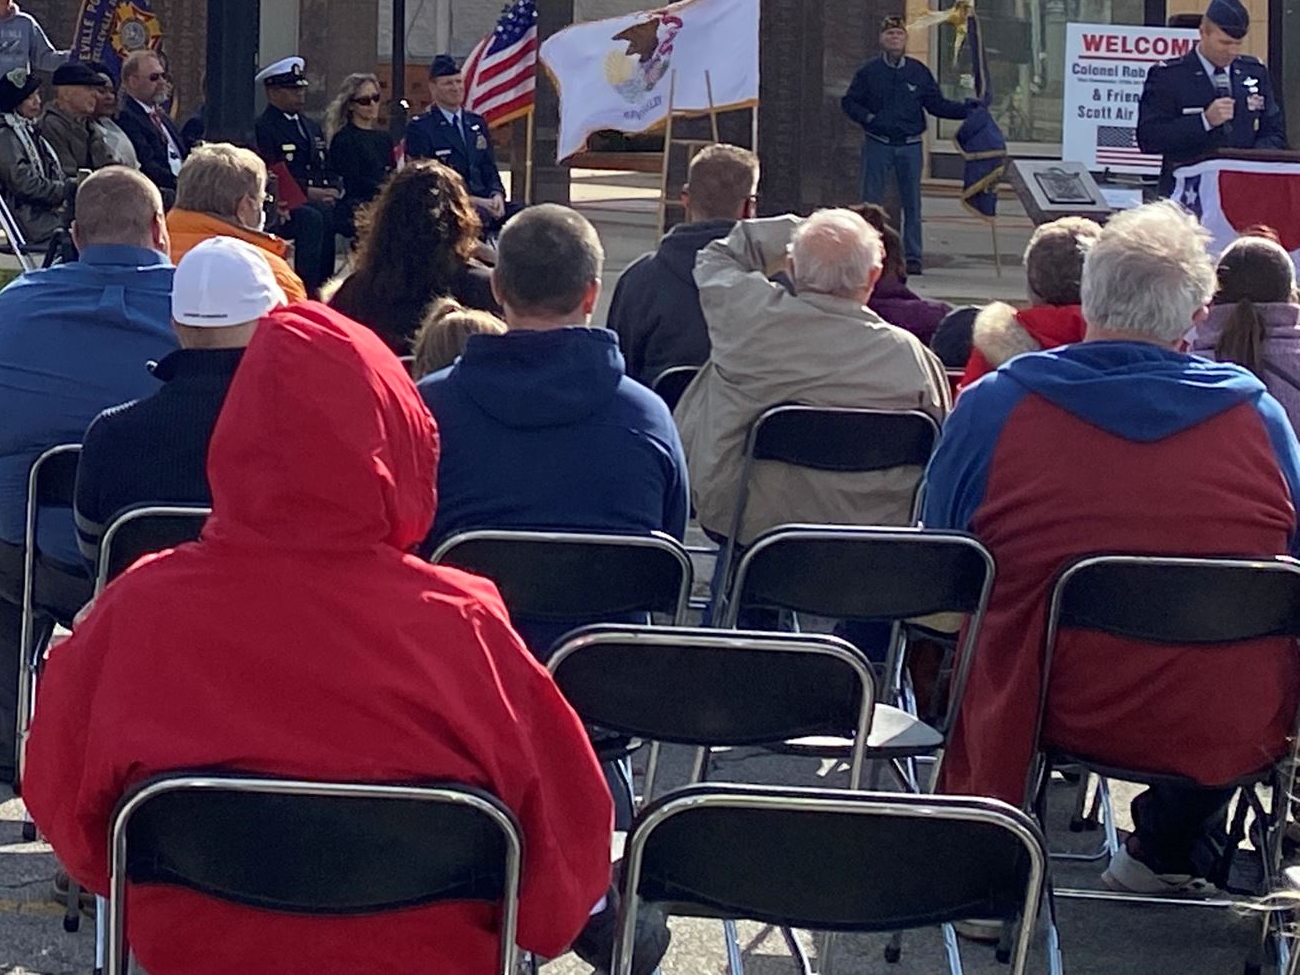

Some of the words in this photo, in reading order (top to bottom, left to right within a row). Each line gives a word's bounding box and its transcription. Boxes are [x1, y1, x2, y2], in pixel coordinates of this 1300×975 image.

[1072, 63, 1118, 77] Colonel
[1122, 66, 1146, 78] Rob
[1092, 88, 1101, 101] &
[1078, 105, 1111, 120] Scott
[1115, 106, 1133, 121] Air
